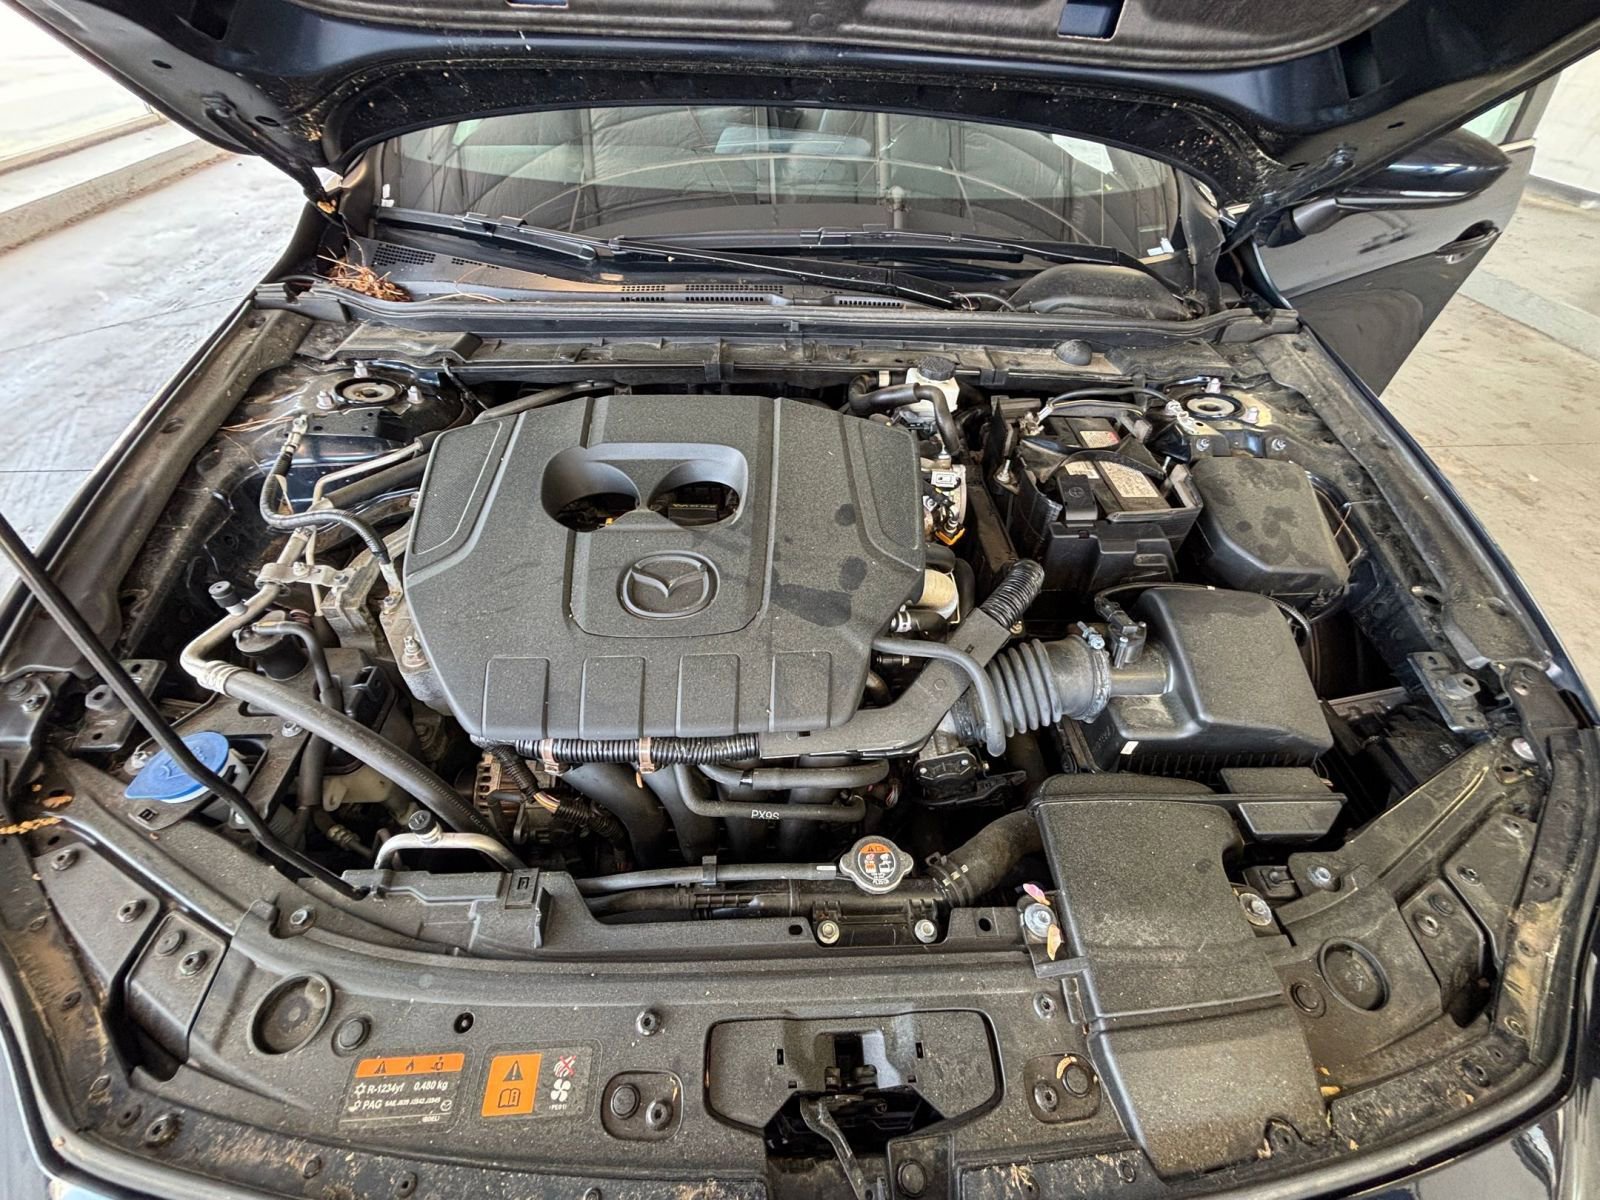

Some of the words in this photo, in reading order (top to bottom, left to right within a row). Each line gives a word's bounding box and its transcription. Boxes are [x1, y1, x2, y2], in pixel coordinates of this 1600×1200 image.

[367, 1082, 405, 1094] R-1234yf
[437, 1080, 448, 1091] kg
[362, 1099, 383, 1110] PAG
